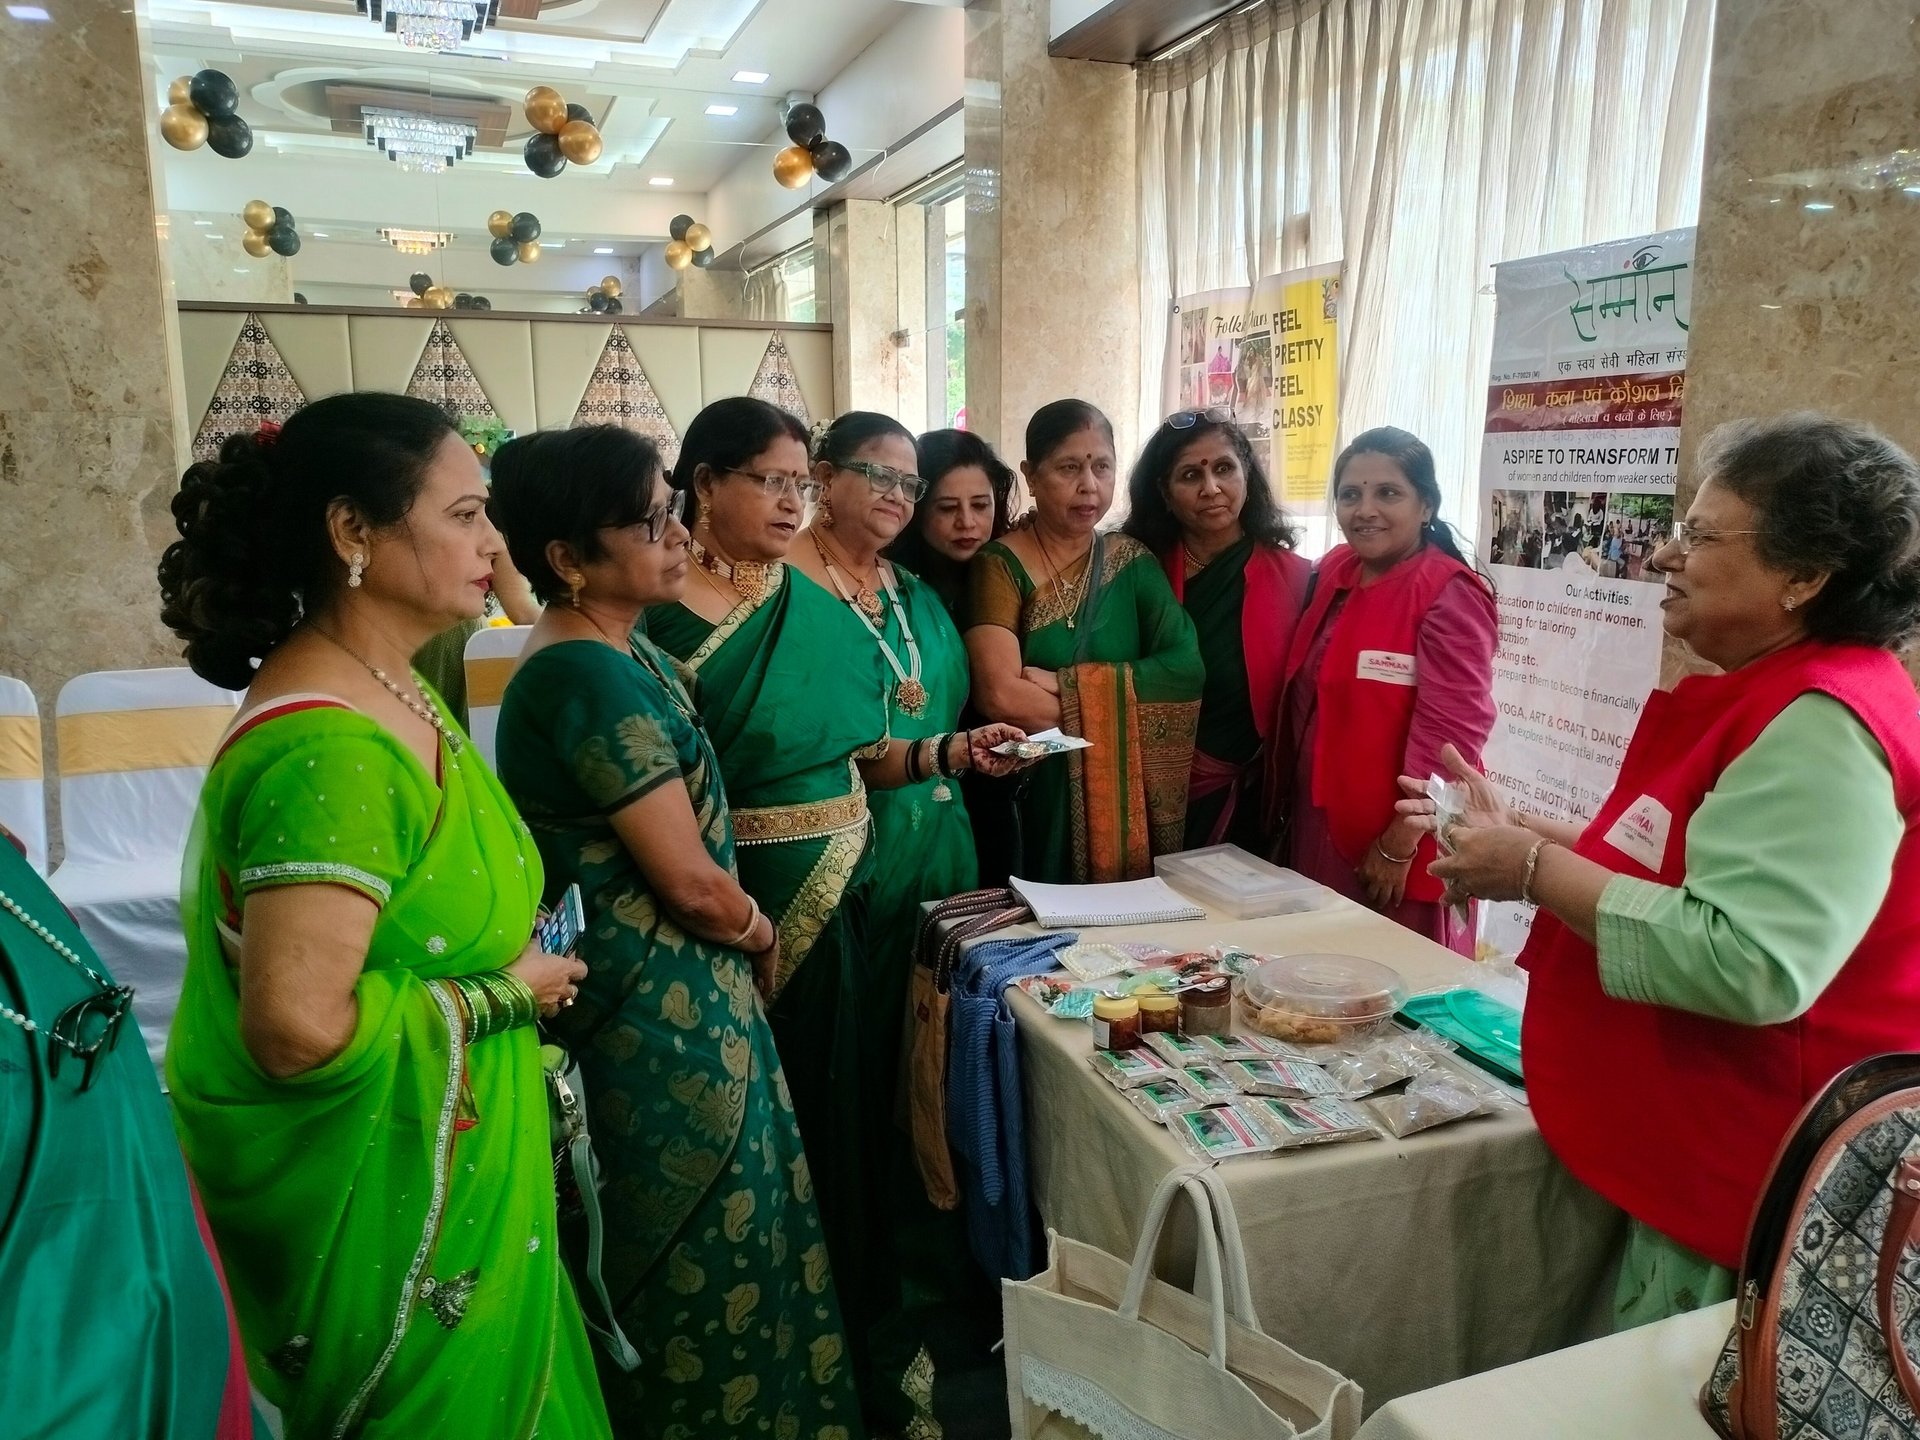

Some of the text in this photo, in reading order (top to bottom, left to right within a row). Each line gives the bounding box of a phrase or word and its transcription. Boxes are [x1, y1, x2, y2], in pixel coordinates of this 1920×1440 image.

[1272, 309, 1302, 335] FEEL
[1275, 338, 1324, 366] PRETTY
[1558, 361, 1572, 374] एक
[1577, 355, 1595, 370] स्वयं
[1601, 353, 1619, 368] सेवी
[1627, 350, 1659, 367] महिला
[1275, 374, 1304, 398] FEEL
[1502, 388, 1537, 411] शिक्षा,
[1545, 390, 1575, 407] कला
[1583, 384, 1602, 404] एवं
[1610, 379, 1659, 404] कौशल
[1273, 404, 1324, 430] CLASSY
[1638, 410, 1646, 422] के
[1503, 450, 1543, 464] ASPIRE
[1547, 449, 1564, 464] TO
[1568, 447, 1659, 464] TRANSFORM
[1508, 471, 1517, 481] of
[1517, 474, 1541, 482] women
[1542, 472, 1557, 482] and
[1559, 471, 1592, 482] children
[1593, 472, 1616, 483] from
[1617, 472, 1647, 484] weaker
[1566, 584, 1632, 605] Our Activities:
[1536, 600, 1545, 611] to
[1547, 601, 1582, 617] children
[1584, 609, 1602, 621] and
[1605, 612, 1647, 629] women.
[1526, 616, 1537, 628] for
[1539, 619, 1577, 639] tailoring
[1522, 654, 1539, 667] etc.
[1498, 668, 1527, 683] prepare
[1529, 673, 1549, 688] them
[1550, 679, 1558, 690] to
[1560, 681, 1590, 699] become
[1591, 689, 1640, 714] financially
[1498, 701, 1527, 720] YOGA,
[1529, 710, 1546, 725] ART
[1548, 716, 1554, 727] &
[1556, 718, 1588, 740] CRAFT,
[1508, 724, 1516, 735] to
[1517, 726, 1543, 744] explore
[1545, 735, 1558, 748] the
[1558, 740, 1594, 761] potential
[1596, 752, 1613, 767] and
[1580, 788, 1590, 800] to
[1509, 797, 1516, 808] &
[1518, 800, 1541, 818] GAIN
[1513, 913, 1523, 924] or
